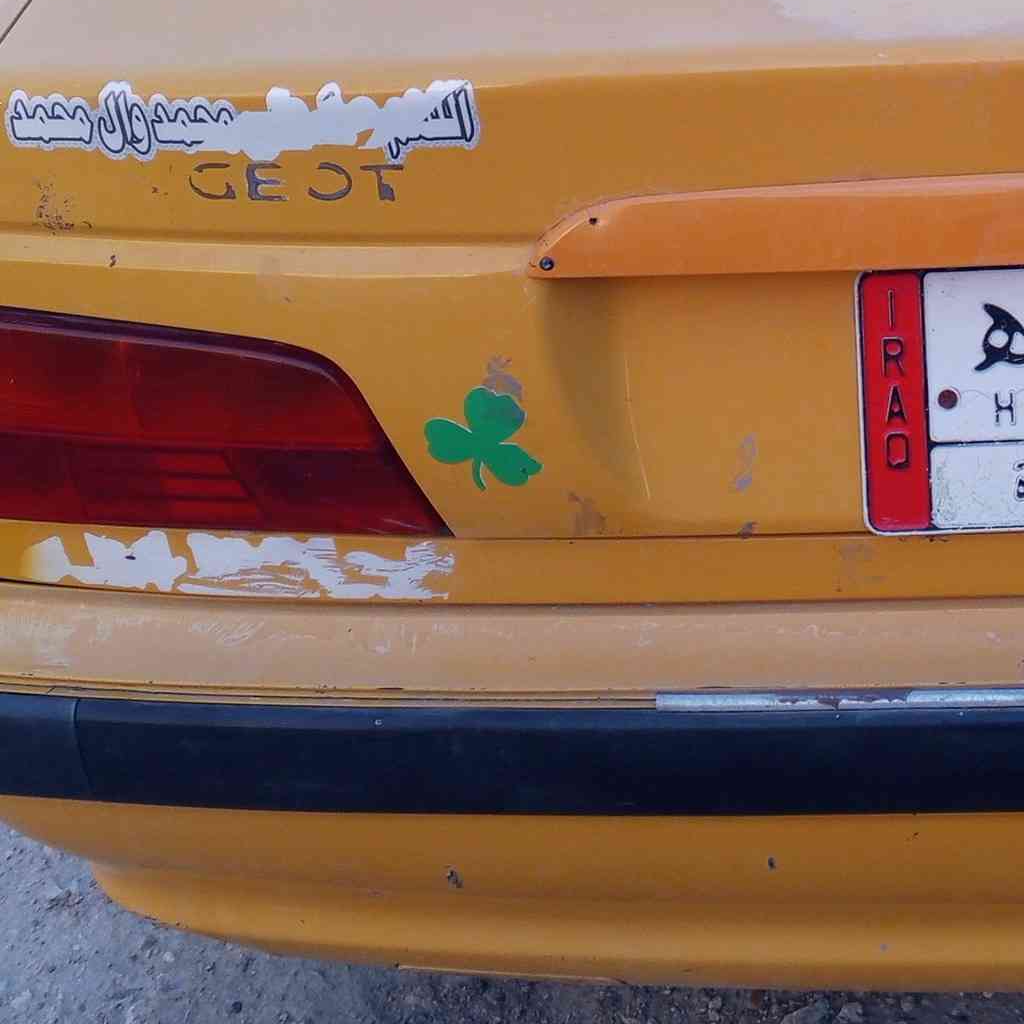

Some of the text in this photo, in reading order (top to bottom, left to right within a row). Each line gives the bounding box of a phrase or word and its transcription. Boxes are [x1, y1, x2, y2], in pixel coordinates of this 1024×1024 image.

[10, 98, 94, 145] محمد
[881, 288, 911, 473] IRAQ
[993, 388, 1017, 426] H
